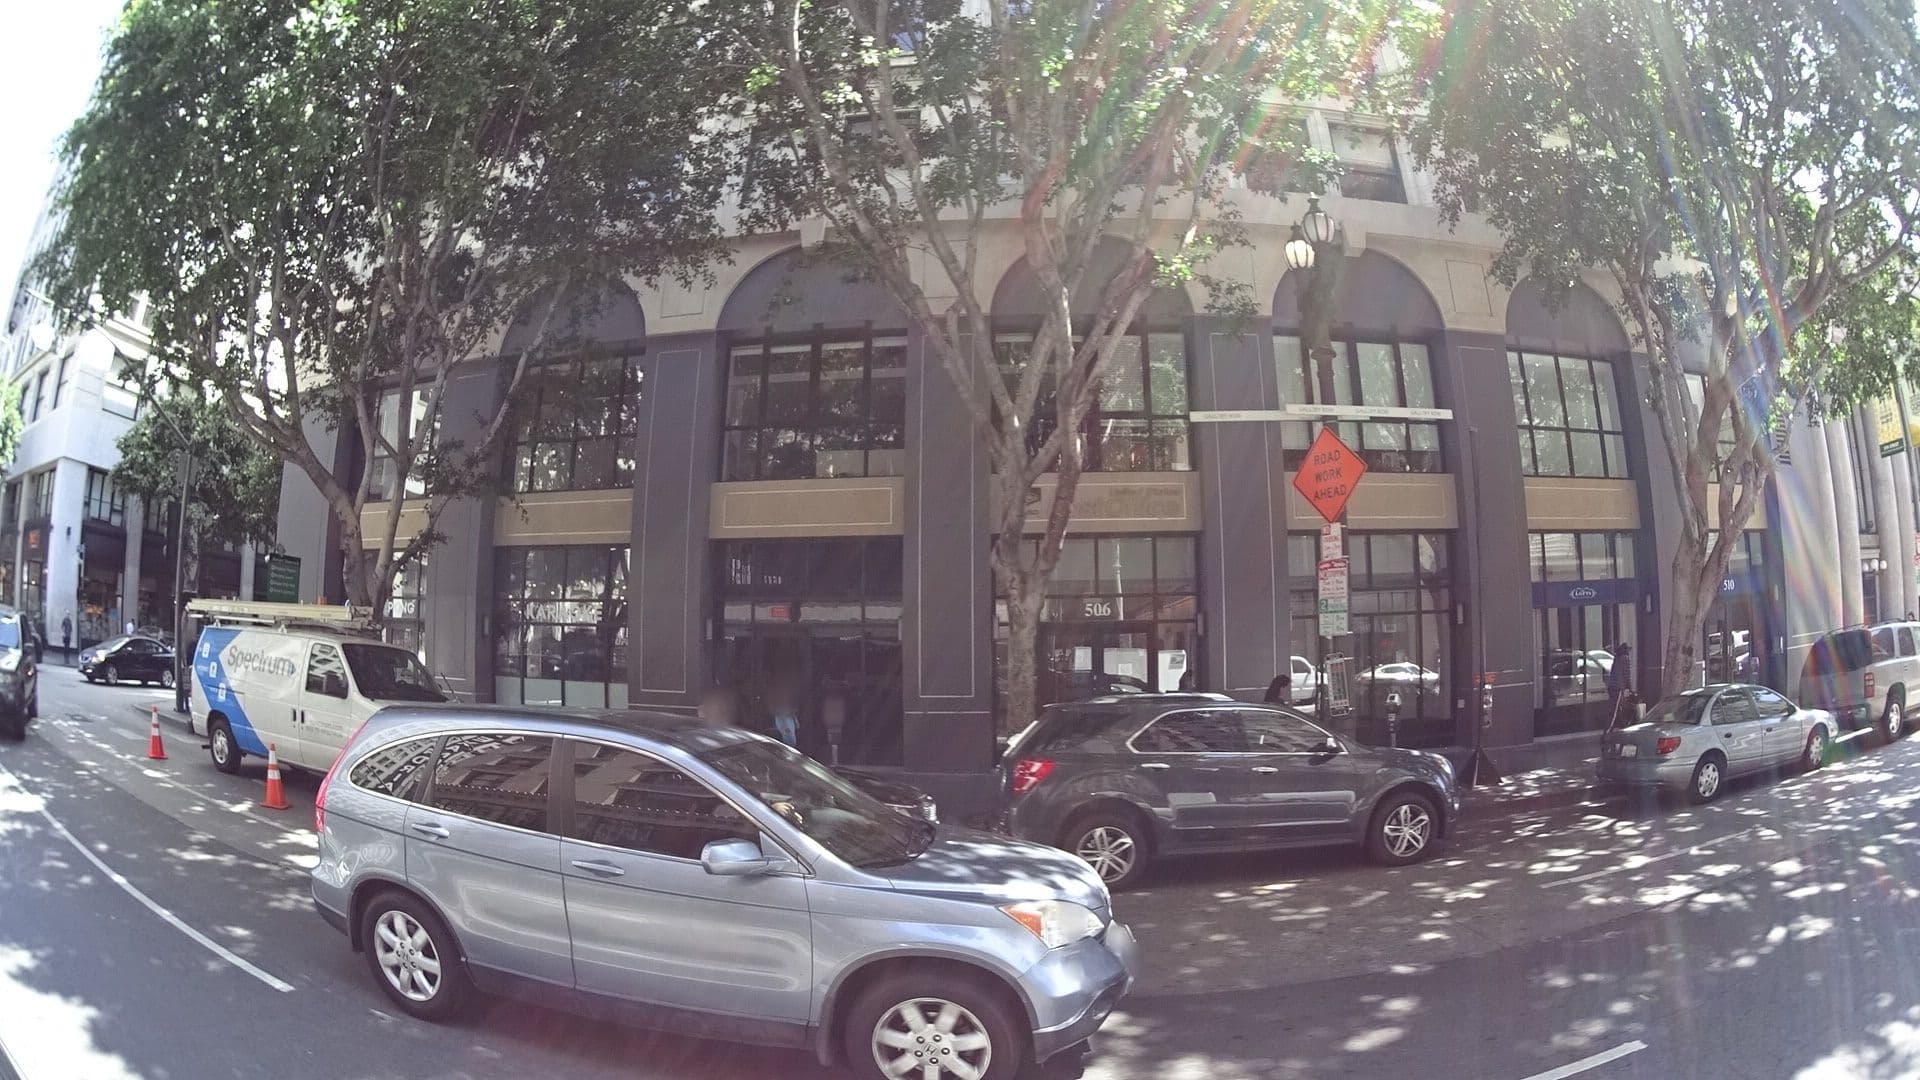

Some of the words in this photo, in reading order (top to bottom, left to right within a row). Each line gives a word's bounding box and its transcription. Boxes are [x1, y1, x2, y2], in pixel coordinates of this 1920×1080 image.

[1314, 449, 1341, 466] ROAD
[1315, 467, 1342, 483] WORK
[1313, 485, 1347, 501] AHEAD
[1723, 579, 1735, 591] 510
[526, 602, 603, 623] KARAOKE
[1084, 602, 1111, 617] 506
[1320, 600, 1327, 610] 2
[227, 645, 291, 676] Spectrum
